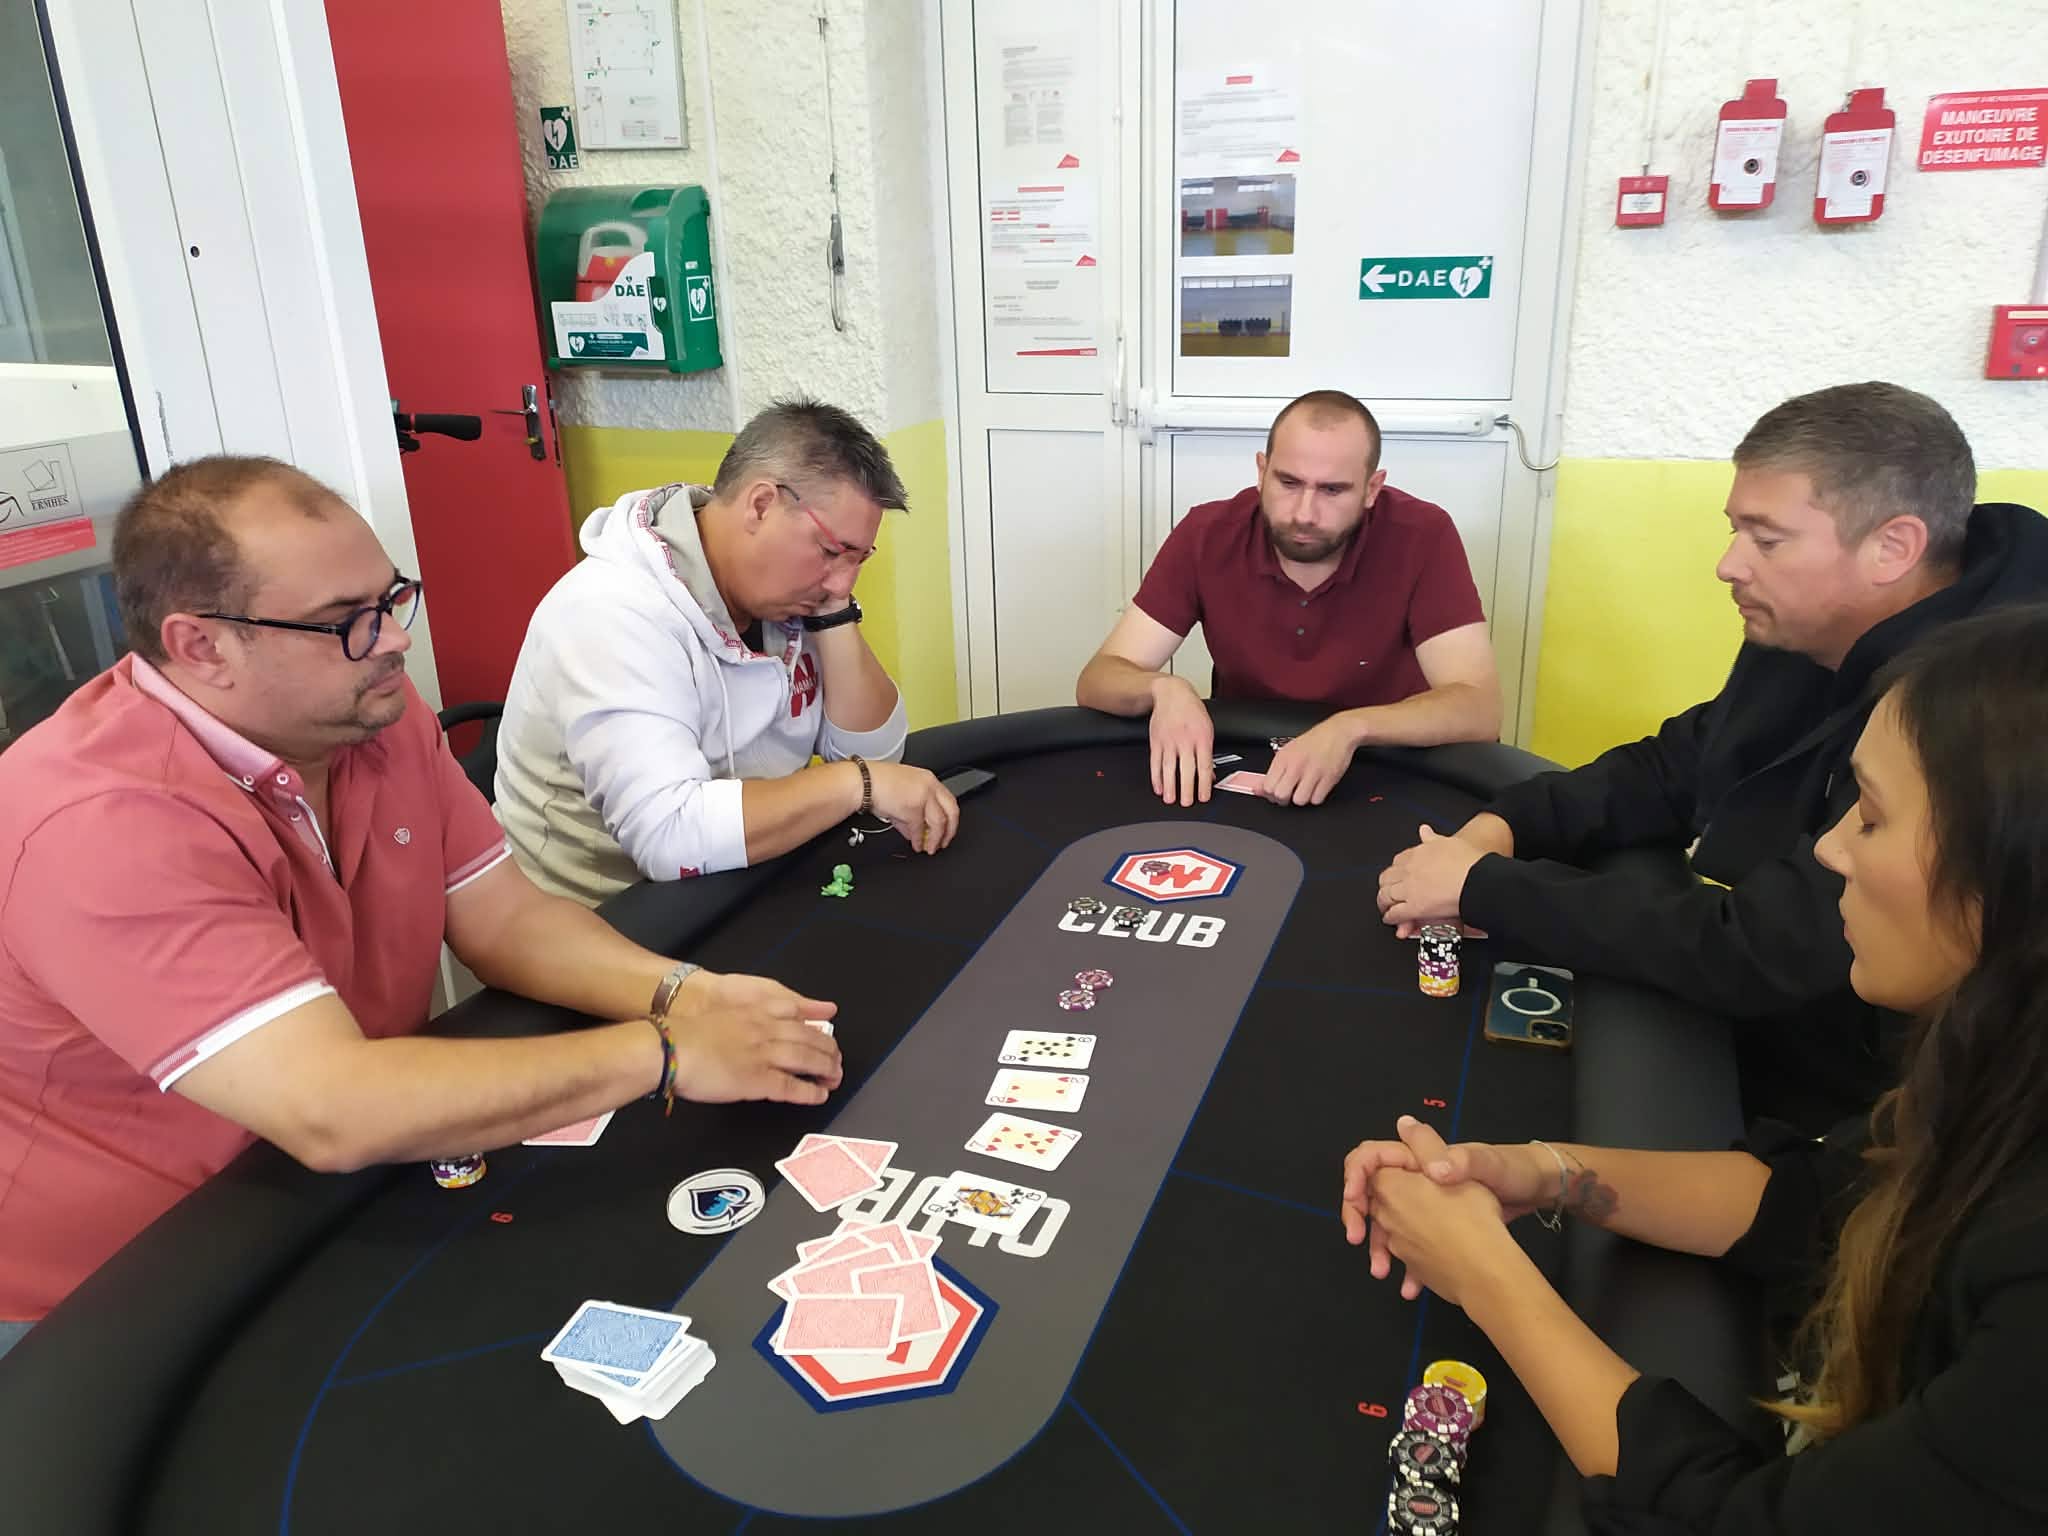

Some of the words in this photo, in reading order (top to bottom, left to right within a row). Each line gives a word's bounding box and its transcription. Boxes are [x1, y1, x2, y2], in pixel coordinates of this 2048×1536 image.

[1932, 127, 2013, 145] EXUTOIRE
[2015, 126, 2039, 142] DE
[548, 154, 577, 169] DAE
[1398, 269, 1448, 287] DAE
[615, 284, 645, 297] DAE
[1057, 901, 1226, 948] CLUB
